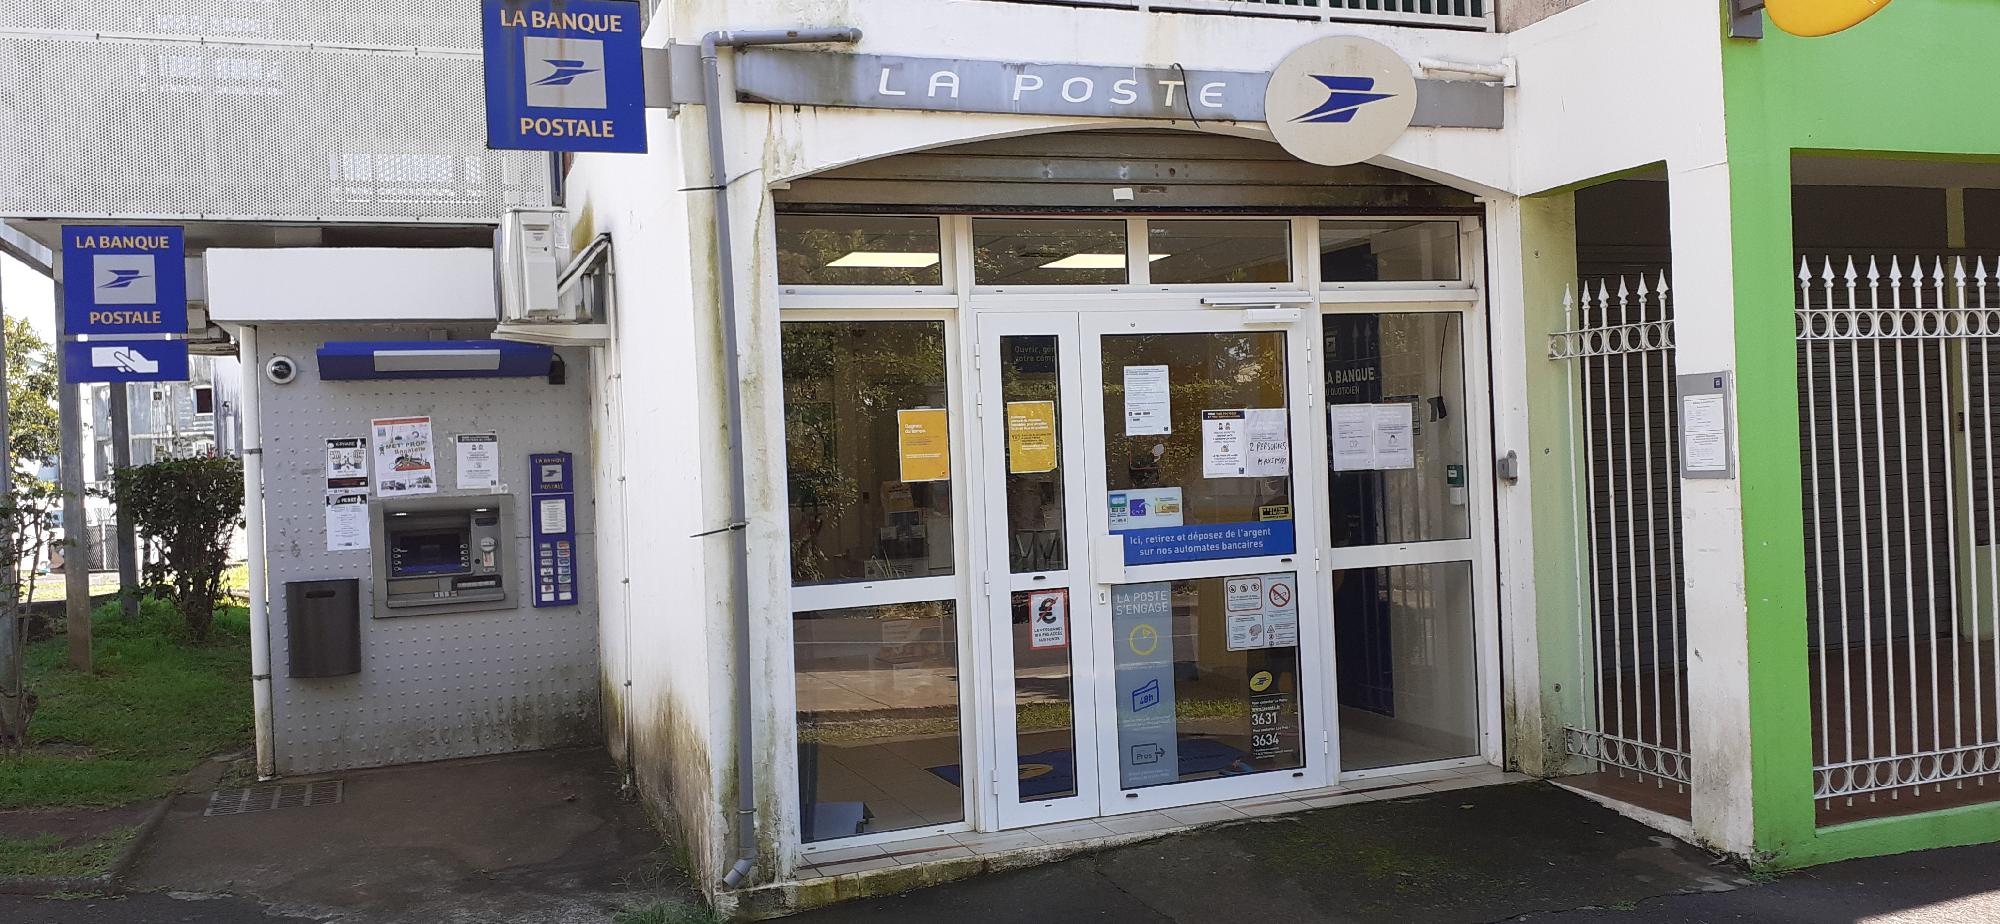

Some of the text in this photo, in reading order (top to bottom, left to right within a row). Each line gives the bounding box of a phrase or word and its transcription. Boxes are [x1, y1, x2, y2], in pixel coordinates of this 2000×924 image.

[500, 9, 623, 34] LA BANQUE
[877, 67, 1227, 108] LA POSTE
[520, 117, 615, 138] POSTALE
[75, 235, 170, 251] LA BANQUE
[89, 311, 162, 325] POSTALE
[1335, 366, 1375, 384] BANQUE
[1249, 442, 1255, 452] 2
[1129, 527, 1271, 546] Ici, retirez et déposez de l'argent
[1139, 540, 1264, 556] sur nos automates bancaires
[1116, 590, 1169, 603] LA POSTE
[1116, 601, 1169, 616] S'ENGAGE
[1252, 712, 1277, 725] 3631
[1252, 733, 1280, 746] 3634
[1136, 753, 1153, 761] Pros
